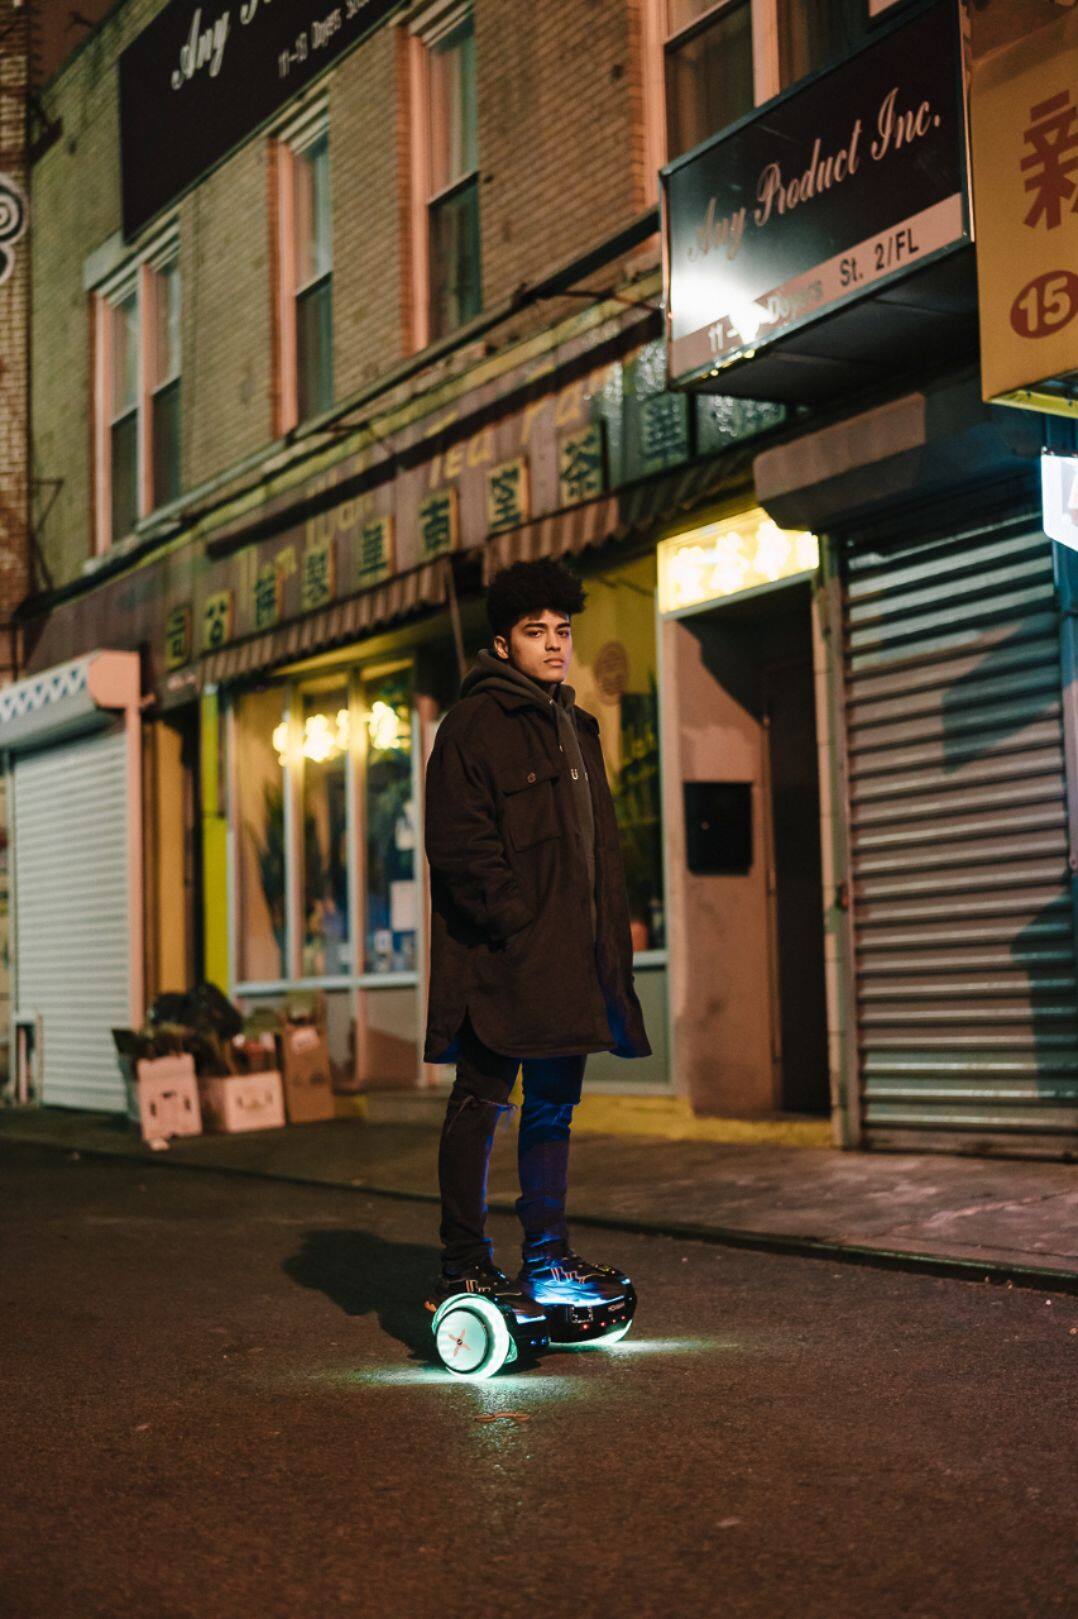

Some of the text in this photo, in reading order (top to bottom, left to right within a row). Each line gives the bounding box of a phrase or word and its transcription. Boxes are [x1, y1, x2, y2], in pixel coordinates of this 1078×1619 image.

[171, 8, 230, 90] Any
[687, 87, 941, 262] Any Product Inc.
[840, 257, 863, 287] St.
[874, 227, 919, 271] 2/FL
[1018, 275, 1072, 333] 15
